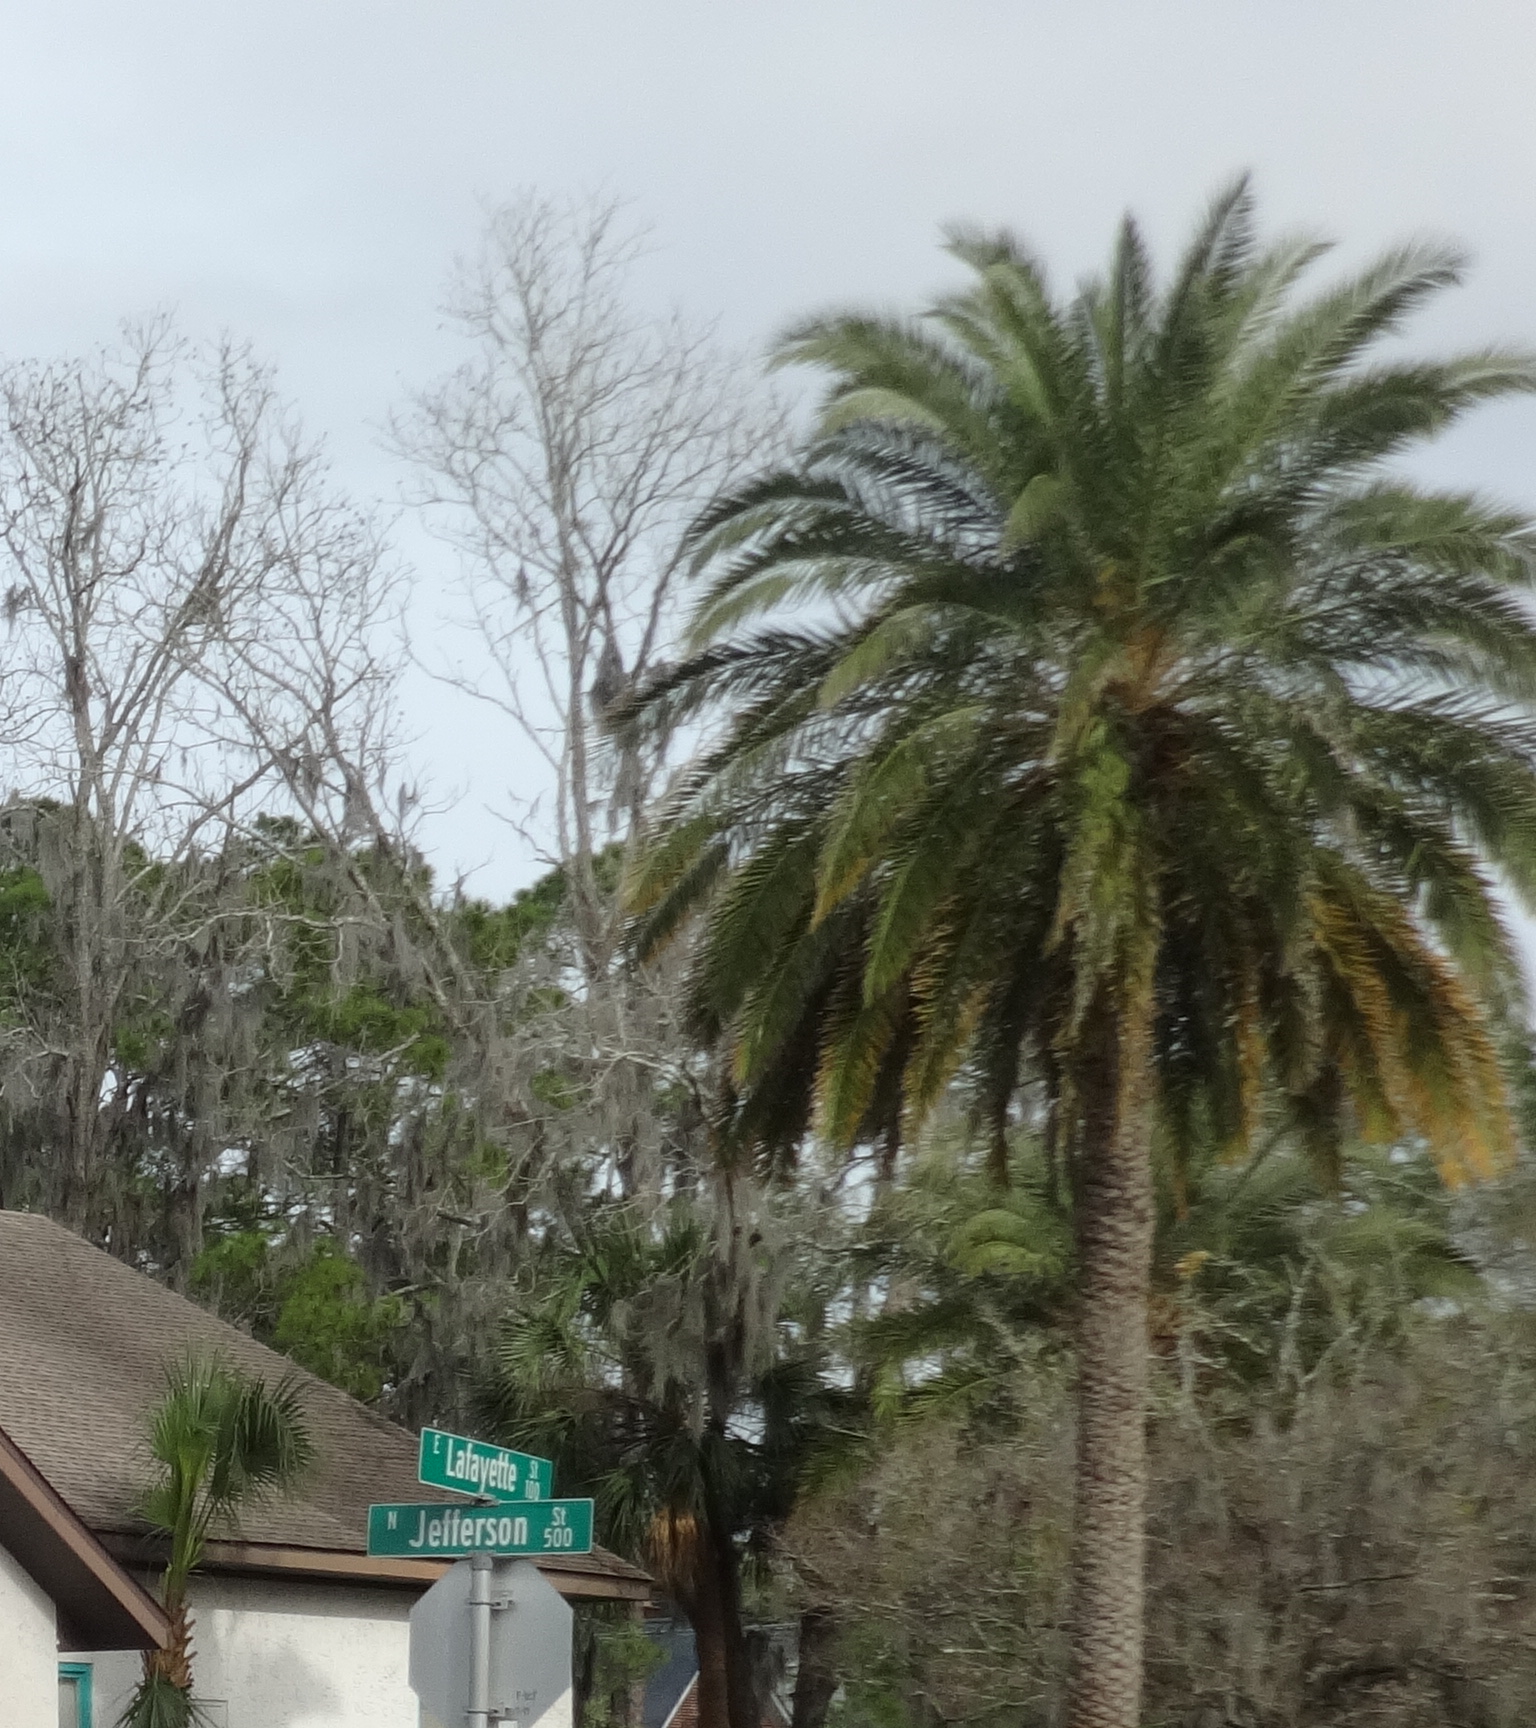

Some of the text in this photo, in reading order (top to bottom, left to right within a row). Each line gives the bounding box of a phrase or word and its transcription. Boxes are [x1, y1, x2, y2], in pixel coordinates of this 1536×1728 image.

[433, 1434, 539, 1493] E Lafayette St
[387, 1506, 566, 1547] N Jefferson St
[543, 1527, 573, 1548] 500
